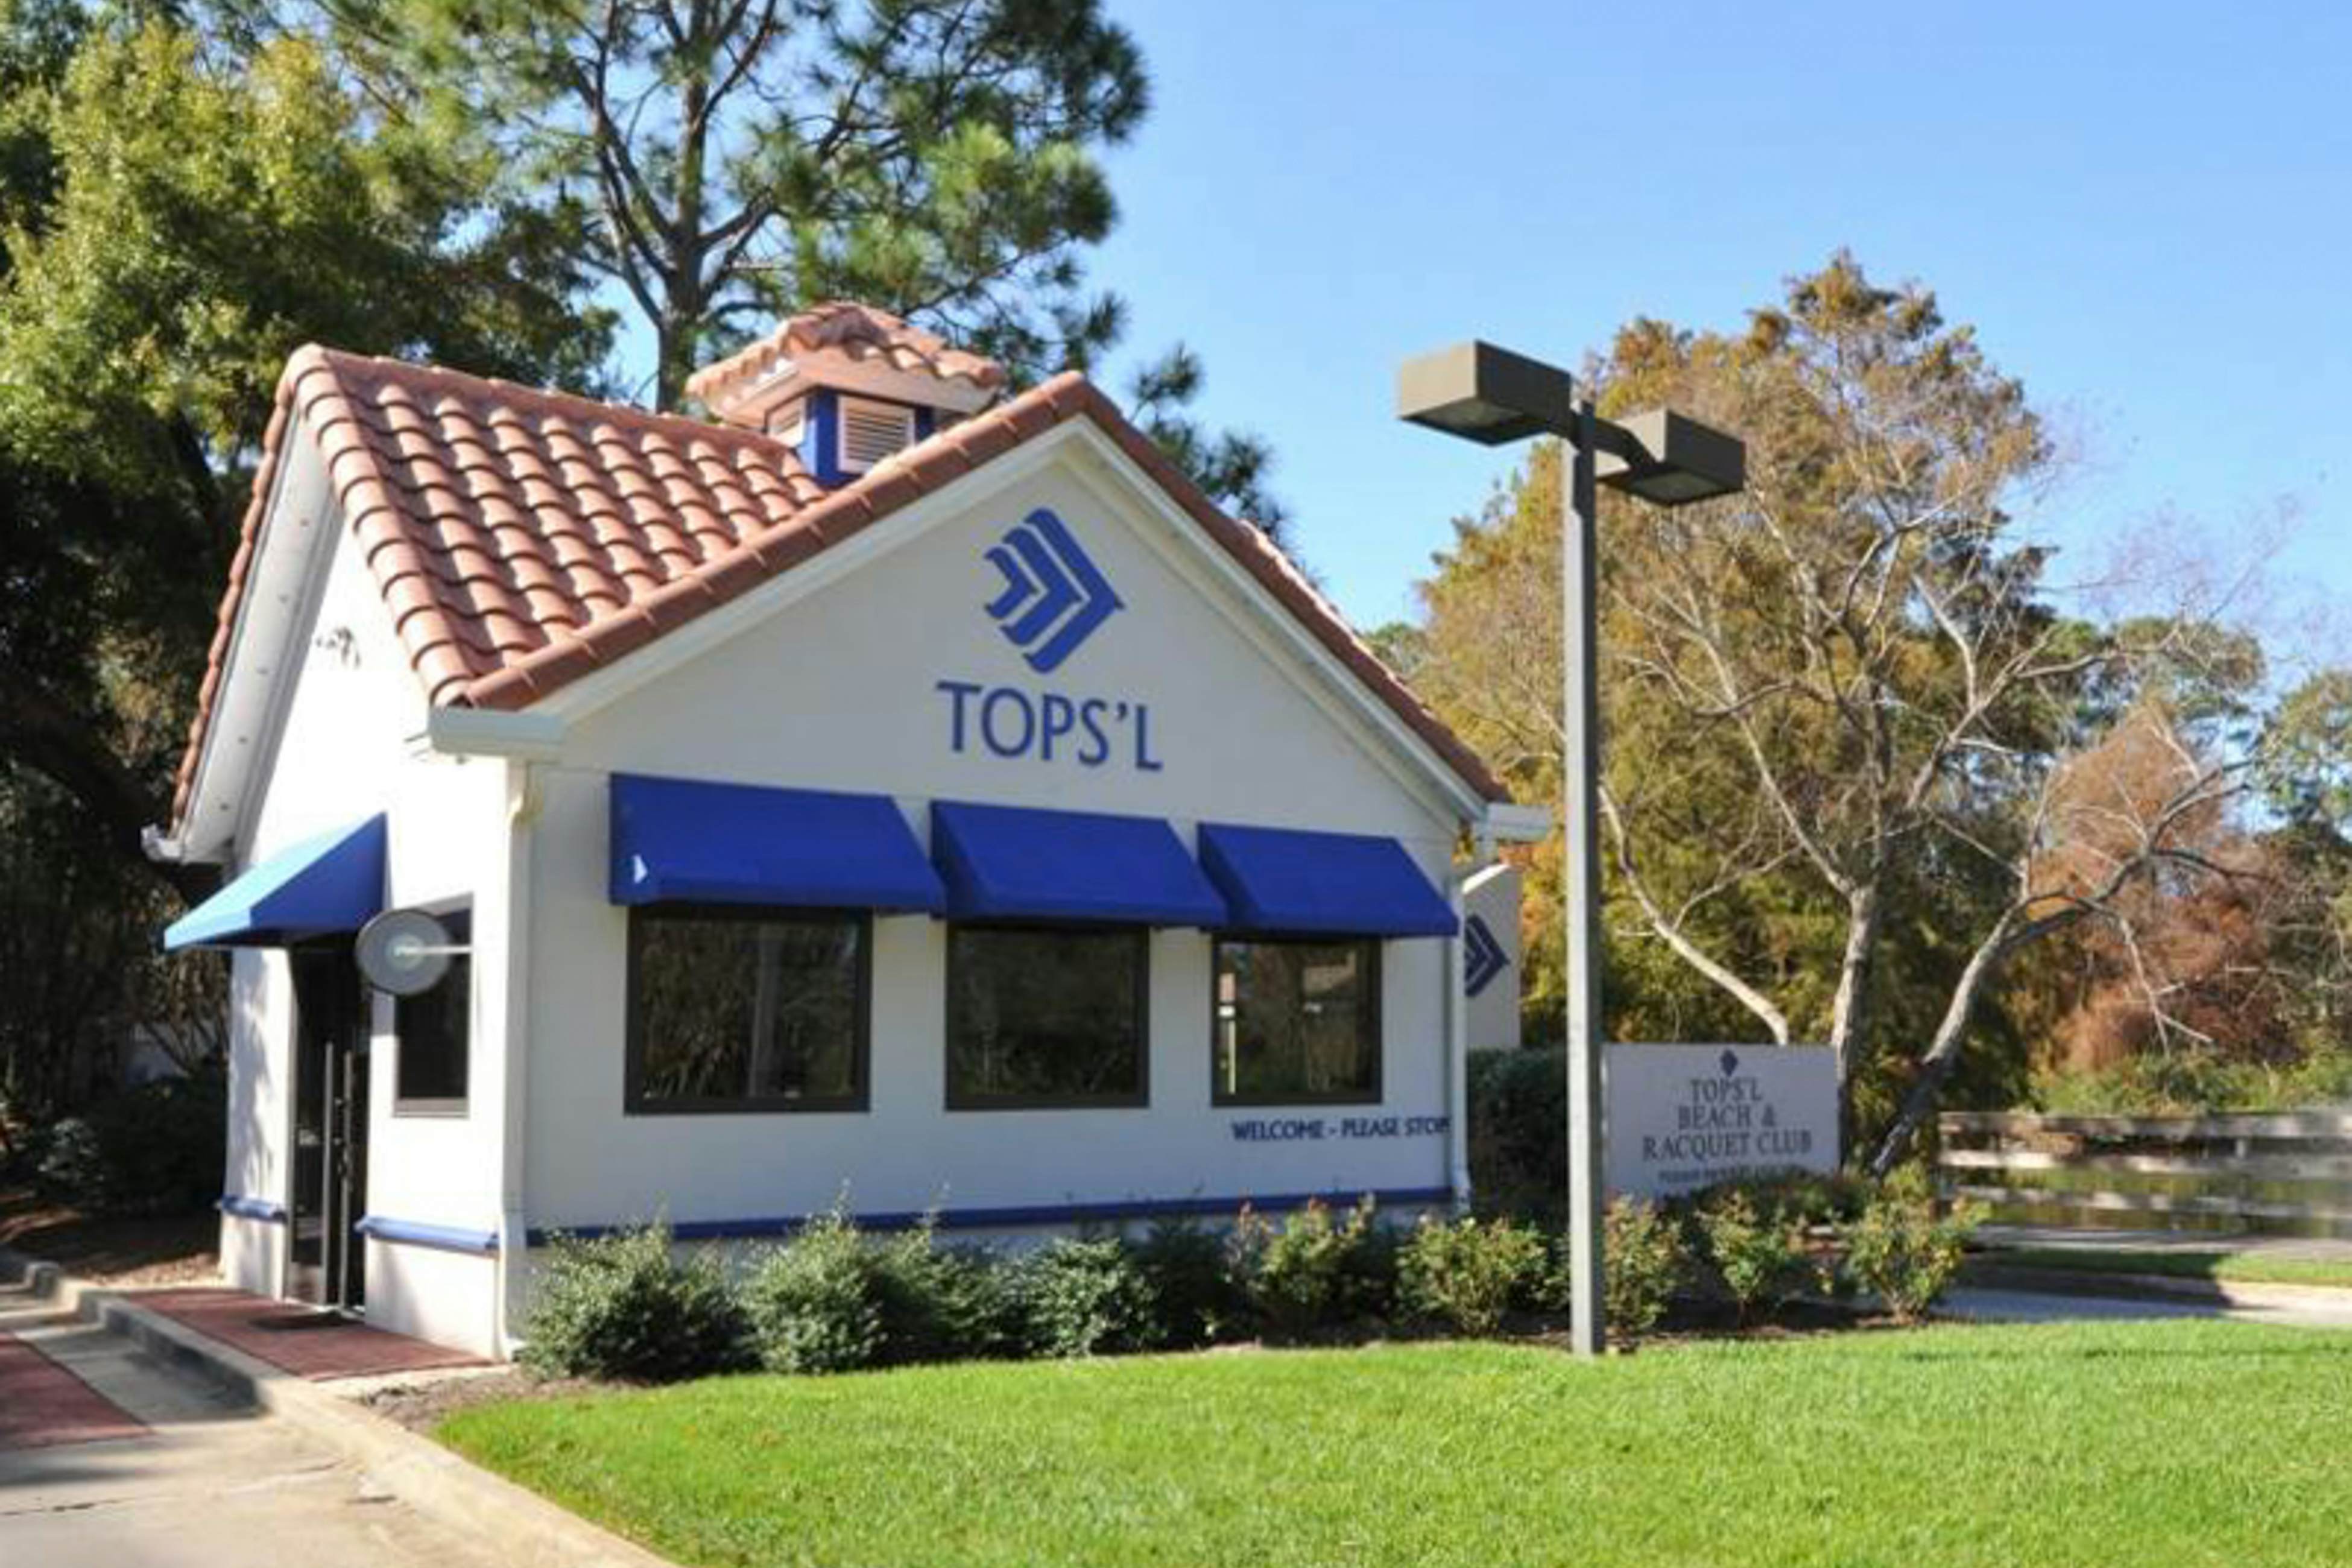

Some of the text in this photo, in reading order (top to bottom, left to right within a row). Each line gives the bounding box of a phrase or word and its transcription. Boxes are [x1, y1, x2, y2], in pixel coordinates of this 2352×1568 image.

[936, 680, 1163, 771] TOPS'L
[1232, 1120, 1324, 1140] WELCOME
[1341, 1118, 1399, 1139] PLEASE
[1678, 1104, 1751, 1130] BEACH
[1643, 1130, 1812, 1161] RACQUET CLUB
